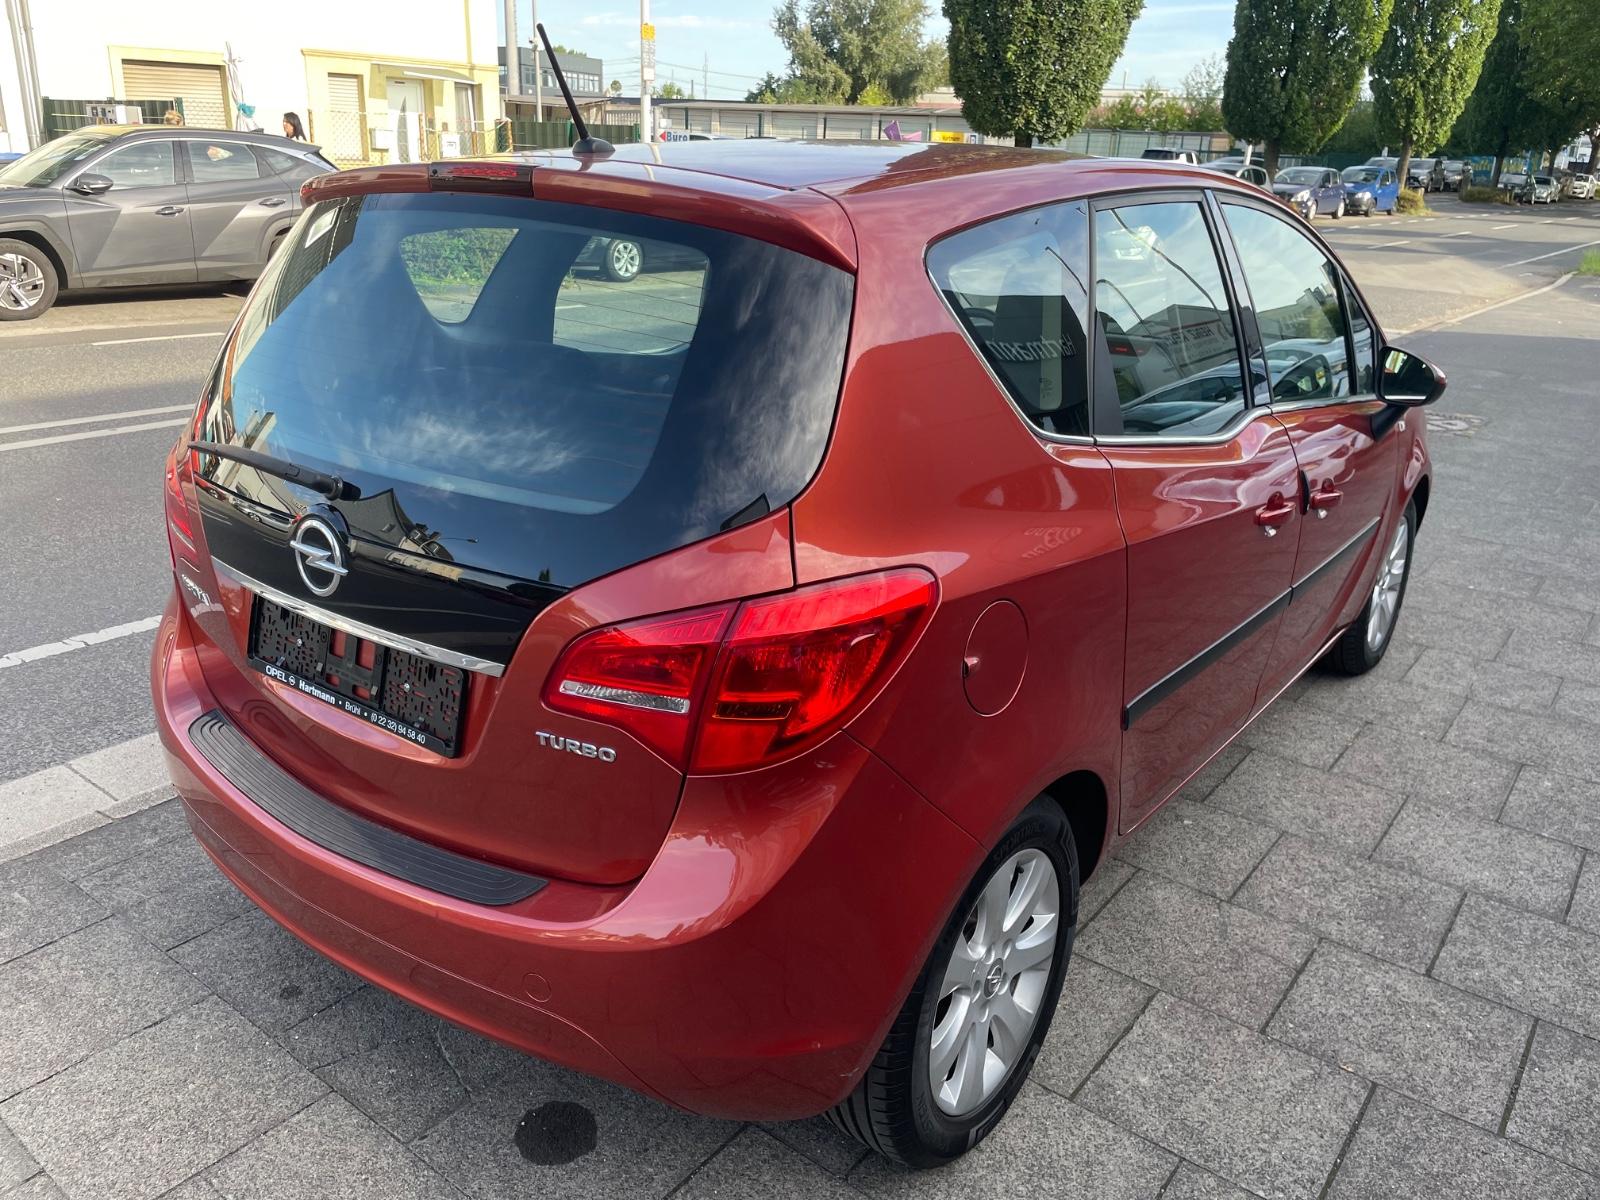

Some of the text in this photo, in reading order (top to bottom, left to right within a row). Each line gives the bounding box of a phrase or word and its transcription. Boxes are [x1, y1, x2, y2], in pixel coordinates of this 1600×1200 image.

[667, 131, 688, 142] Büro
[265, 665, 287, 683] OPEL
[299, 680, 336, 705] Hartmann
[345, 701, 360, 715] Brühl
[378, 715, 387, 727] 22
[387, 719, 397, 732] 32)
[398, 724, 406, 735] 94
[407, 728, 416, 739] 58
[416, 733, 426, 744] 40
[535, 731, 617, 763] TURBO
